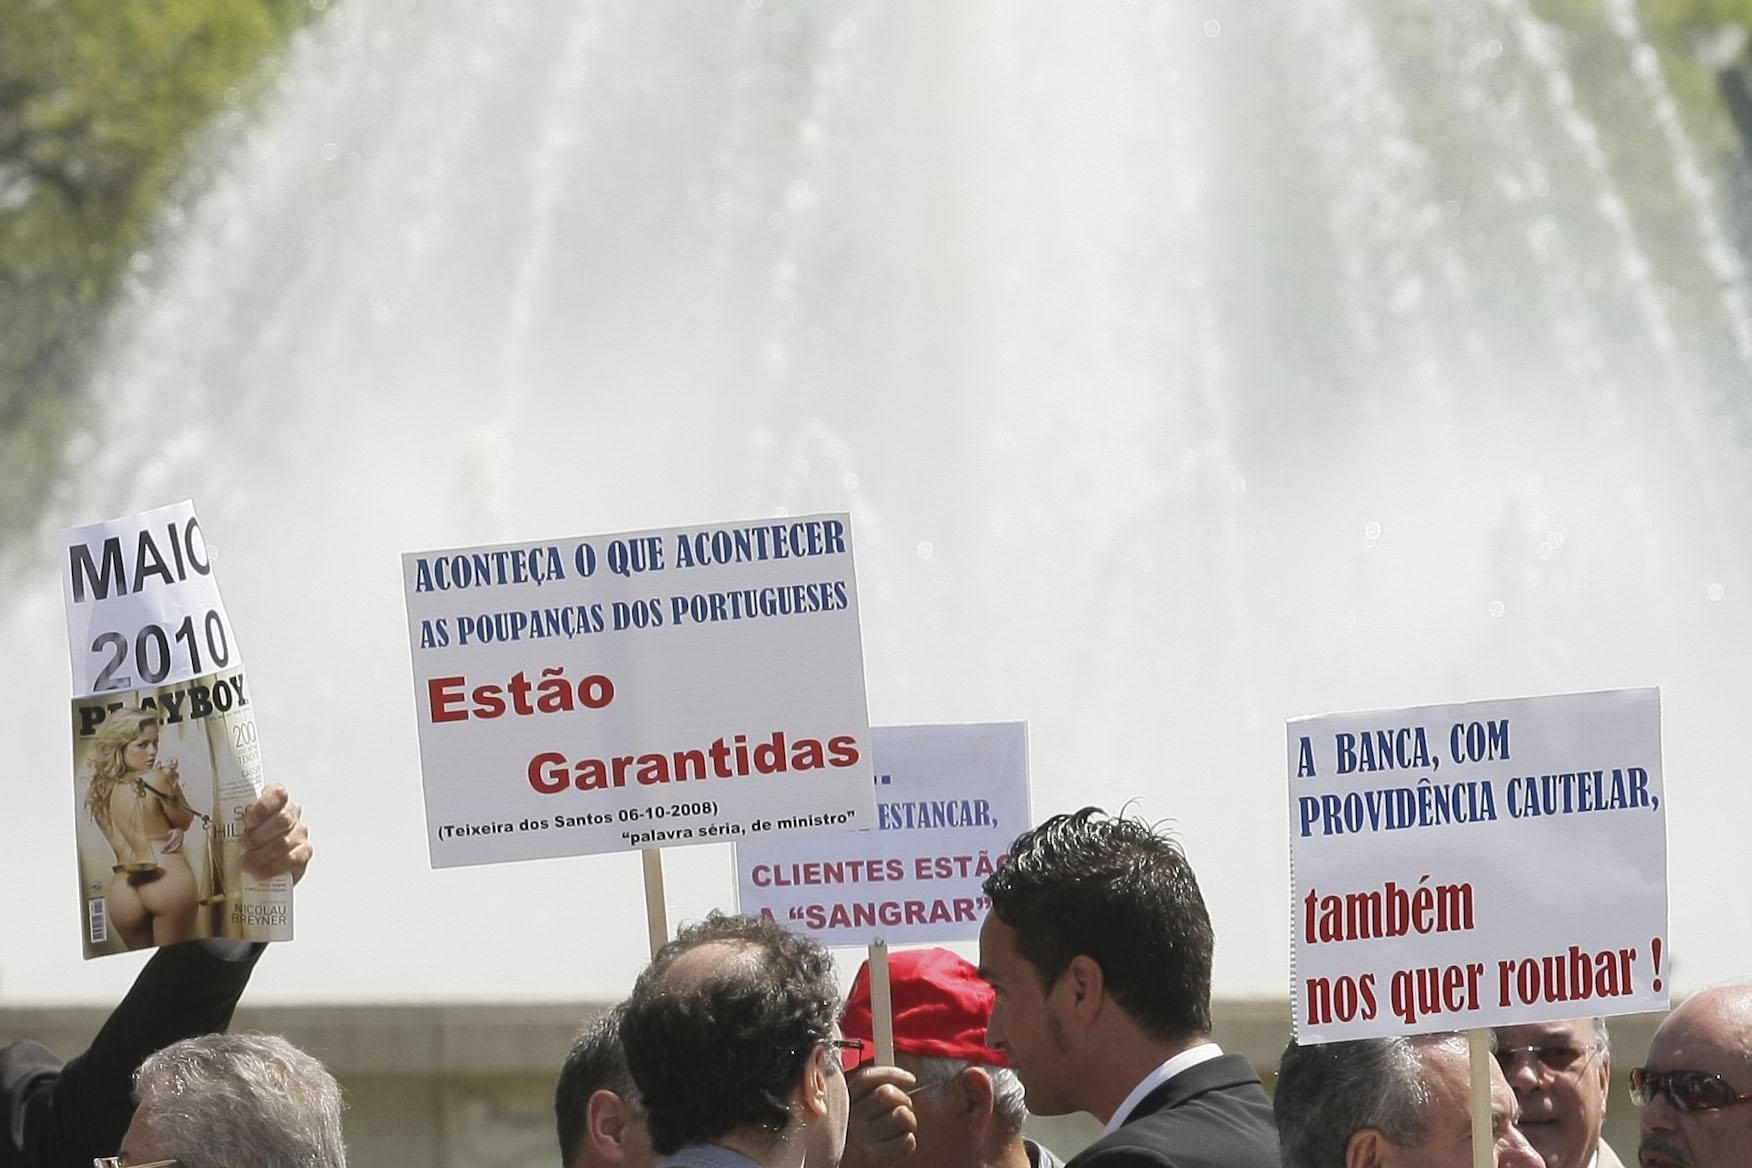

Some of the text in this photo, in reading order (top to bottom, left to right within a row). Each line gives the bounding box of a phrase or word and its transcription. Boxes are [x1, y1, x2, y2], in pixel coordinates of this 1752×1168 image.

[415, 518, 846, 593] ACONTEÇA O QUE ACONTECER
[420, 580, 848, 649] AS POUPANÇAS DOS PORTUGUESES
[91, 610, 228, 692] 2010
[428, 667, 614, 723] Estão
[528, 732, 859, 794] Garantidas
[1297, 719, 1510, 778] A BANCA, COM
[437, 801, 717, 844] (Teixeira dos Santos 06-10-2008)
[621, 810, 856, 846] “palavra séria, de ministro”
[1298, 768, 1659, 837] PROVIDÊNCIA CAUTELAR,
[752, 855, 904, 887] CLIENTES
[232, 914, 286, 926] BREYNER
[235, 903, 286, 915] NICOLAU
[789, 897, 992, 930] “SANGRAR”
[1305, 875, 1474, 944] também
[1306, 973, 1377, 1025] nos
[1391, 963, 1484, 1024] quer
[1498, 946, 1636, 1007] roubar
